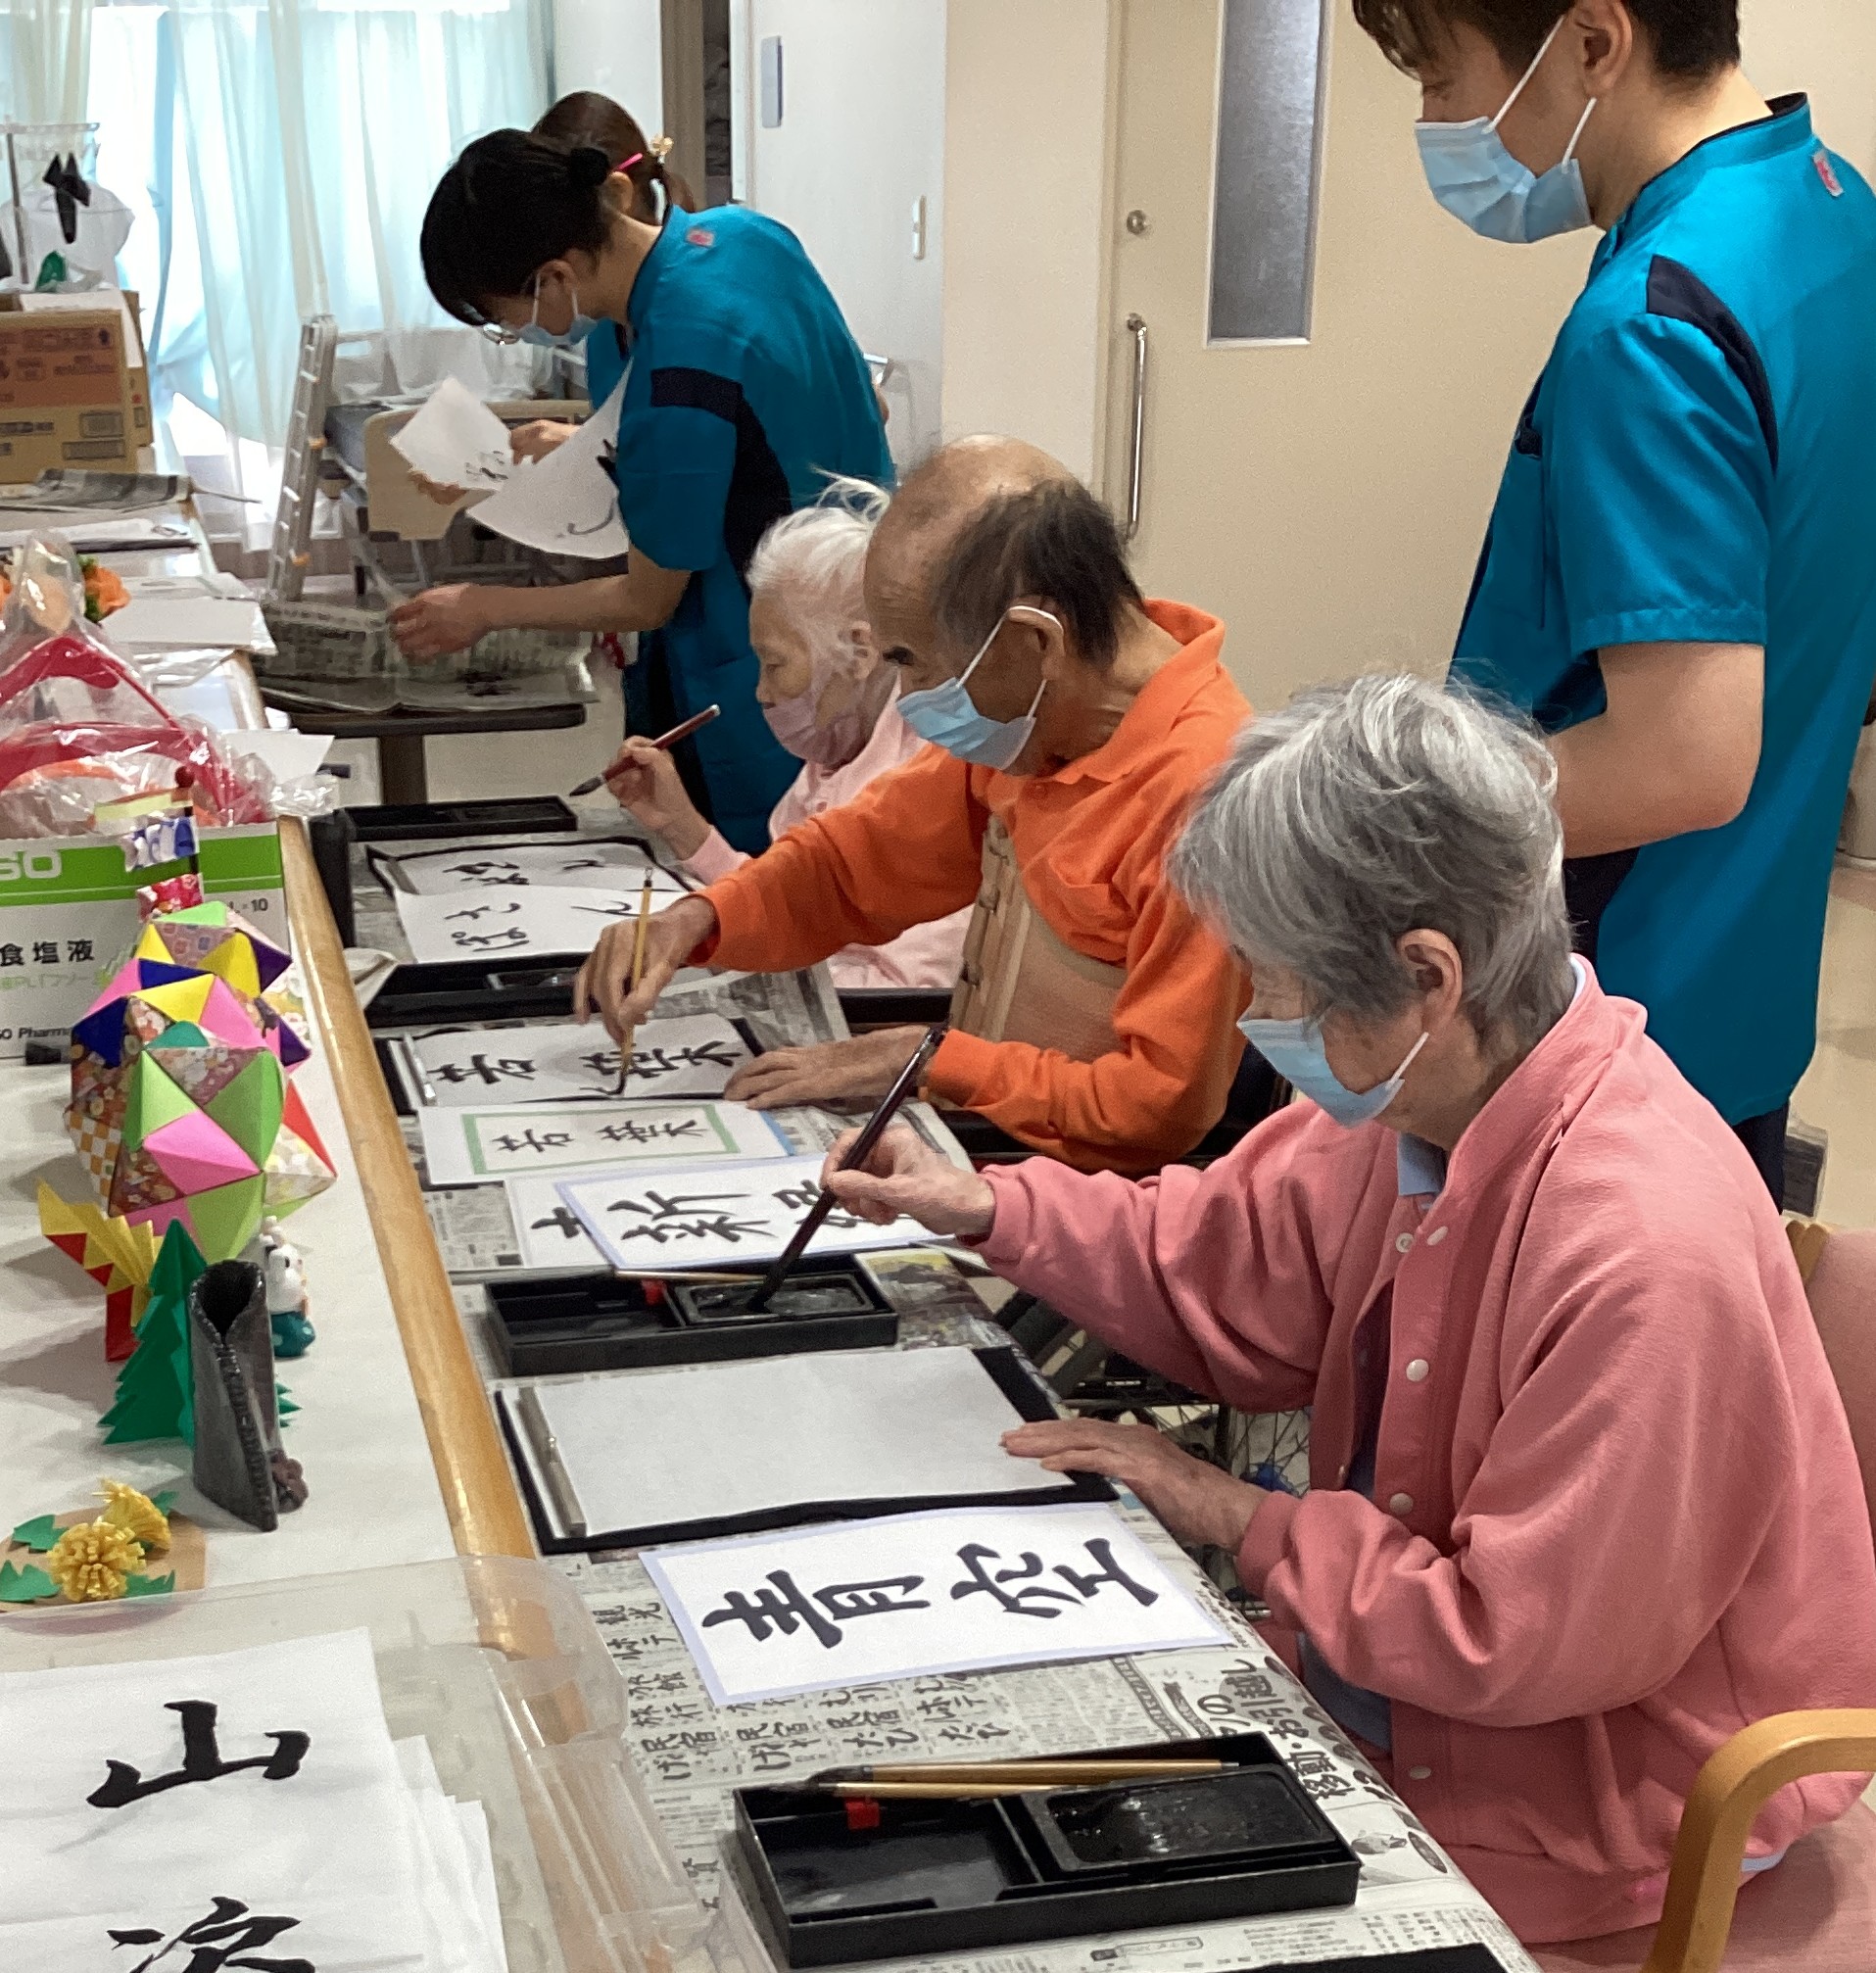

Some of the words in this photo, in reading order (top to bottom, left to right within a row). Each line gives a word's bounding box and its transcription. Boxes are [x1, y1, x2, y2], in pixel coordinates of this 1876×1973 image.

[0, 938, 95, 967] 食塩液
[491, 1119, 707, 1153] 若葉
[701, 1537, 1160, 1649] 青空
